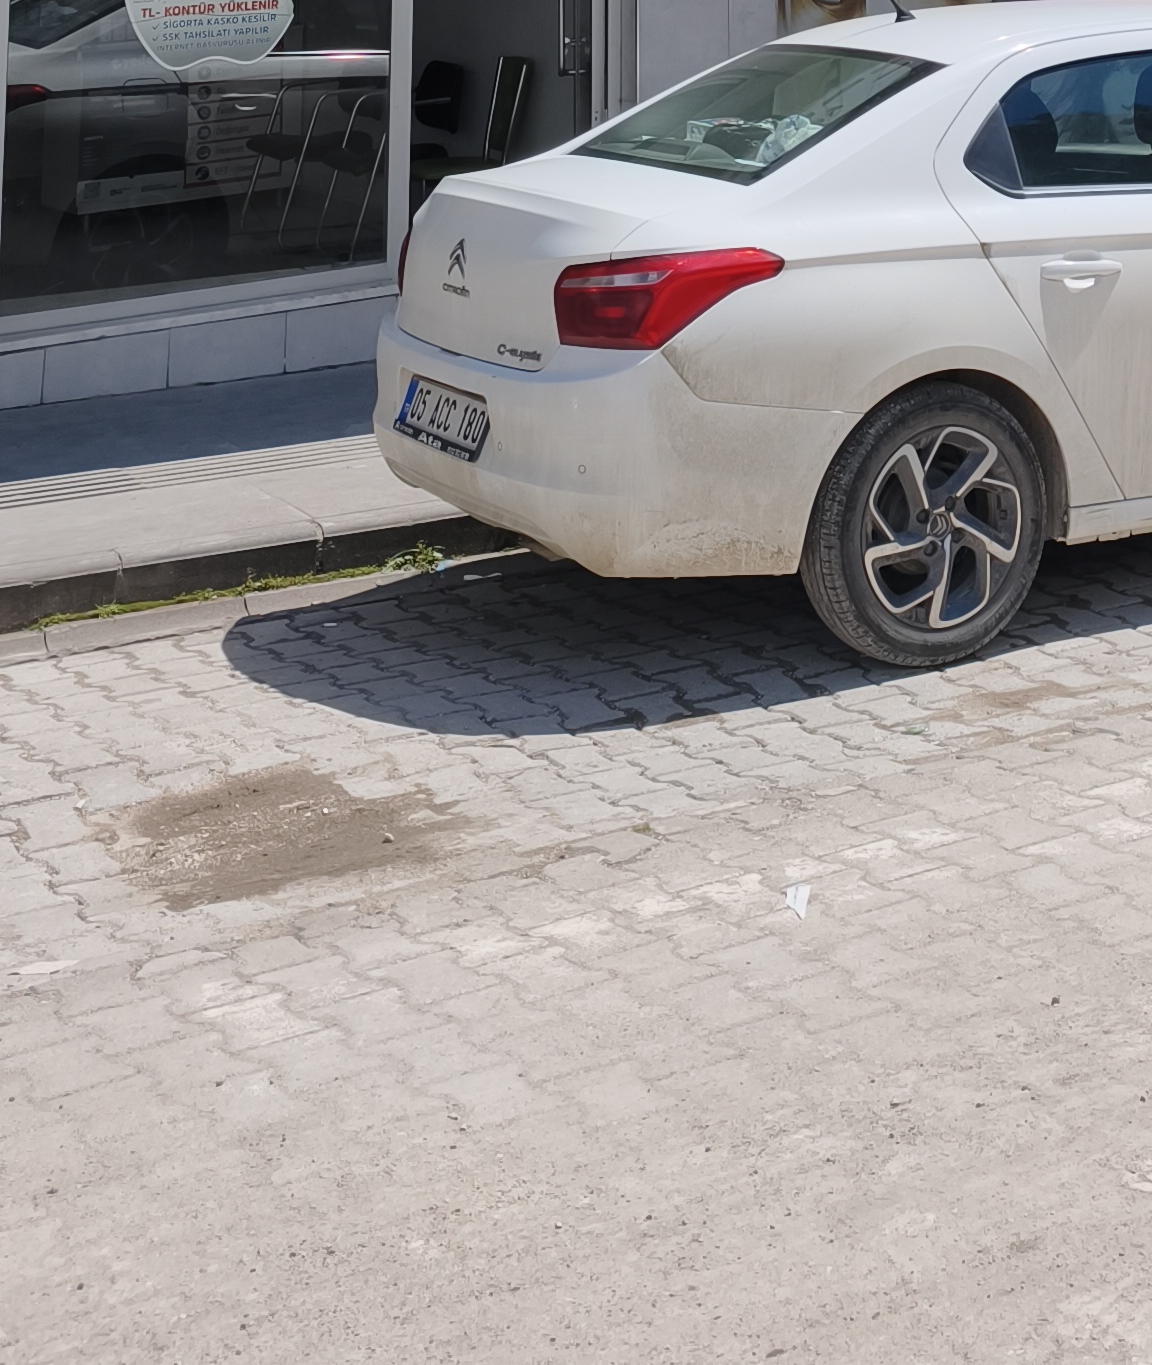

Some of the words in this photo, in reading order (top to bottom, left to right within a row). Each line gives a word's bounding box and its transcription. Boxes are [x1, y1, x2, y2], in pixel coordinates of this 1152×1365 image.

[164, 2, 215, 17] KONTÜR
[163, 18, 204, 30] SİGORTA
[207, 16, 239, 26] KASKO
[241, 13, 277, 24] KESİLİR
[162, 32, 181, 42] SSK
[184, 29, 231, 40] TAHSİLATI
[233, 26, 269, 36] YAPILIR
[410, 387, 432, 422] 05
[427, 394, 457, 433] ACC
[456, 403, 486, 444] 180
